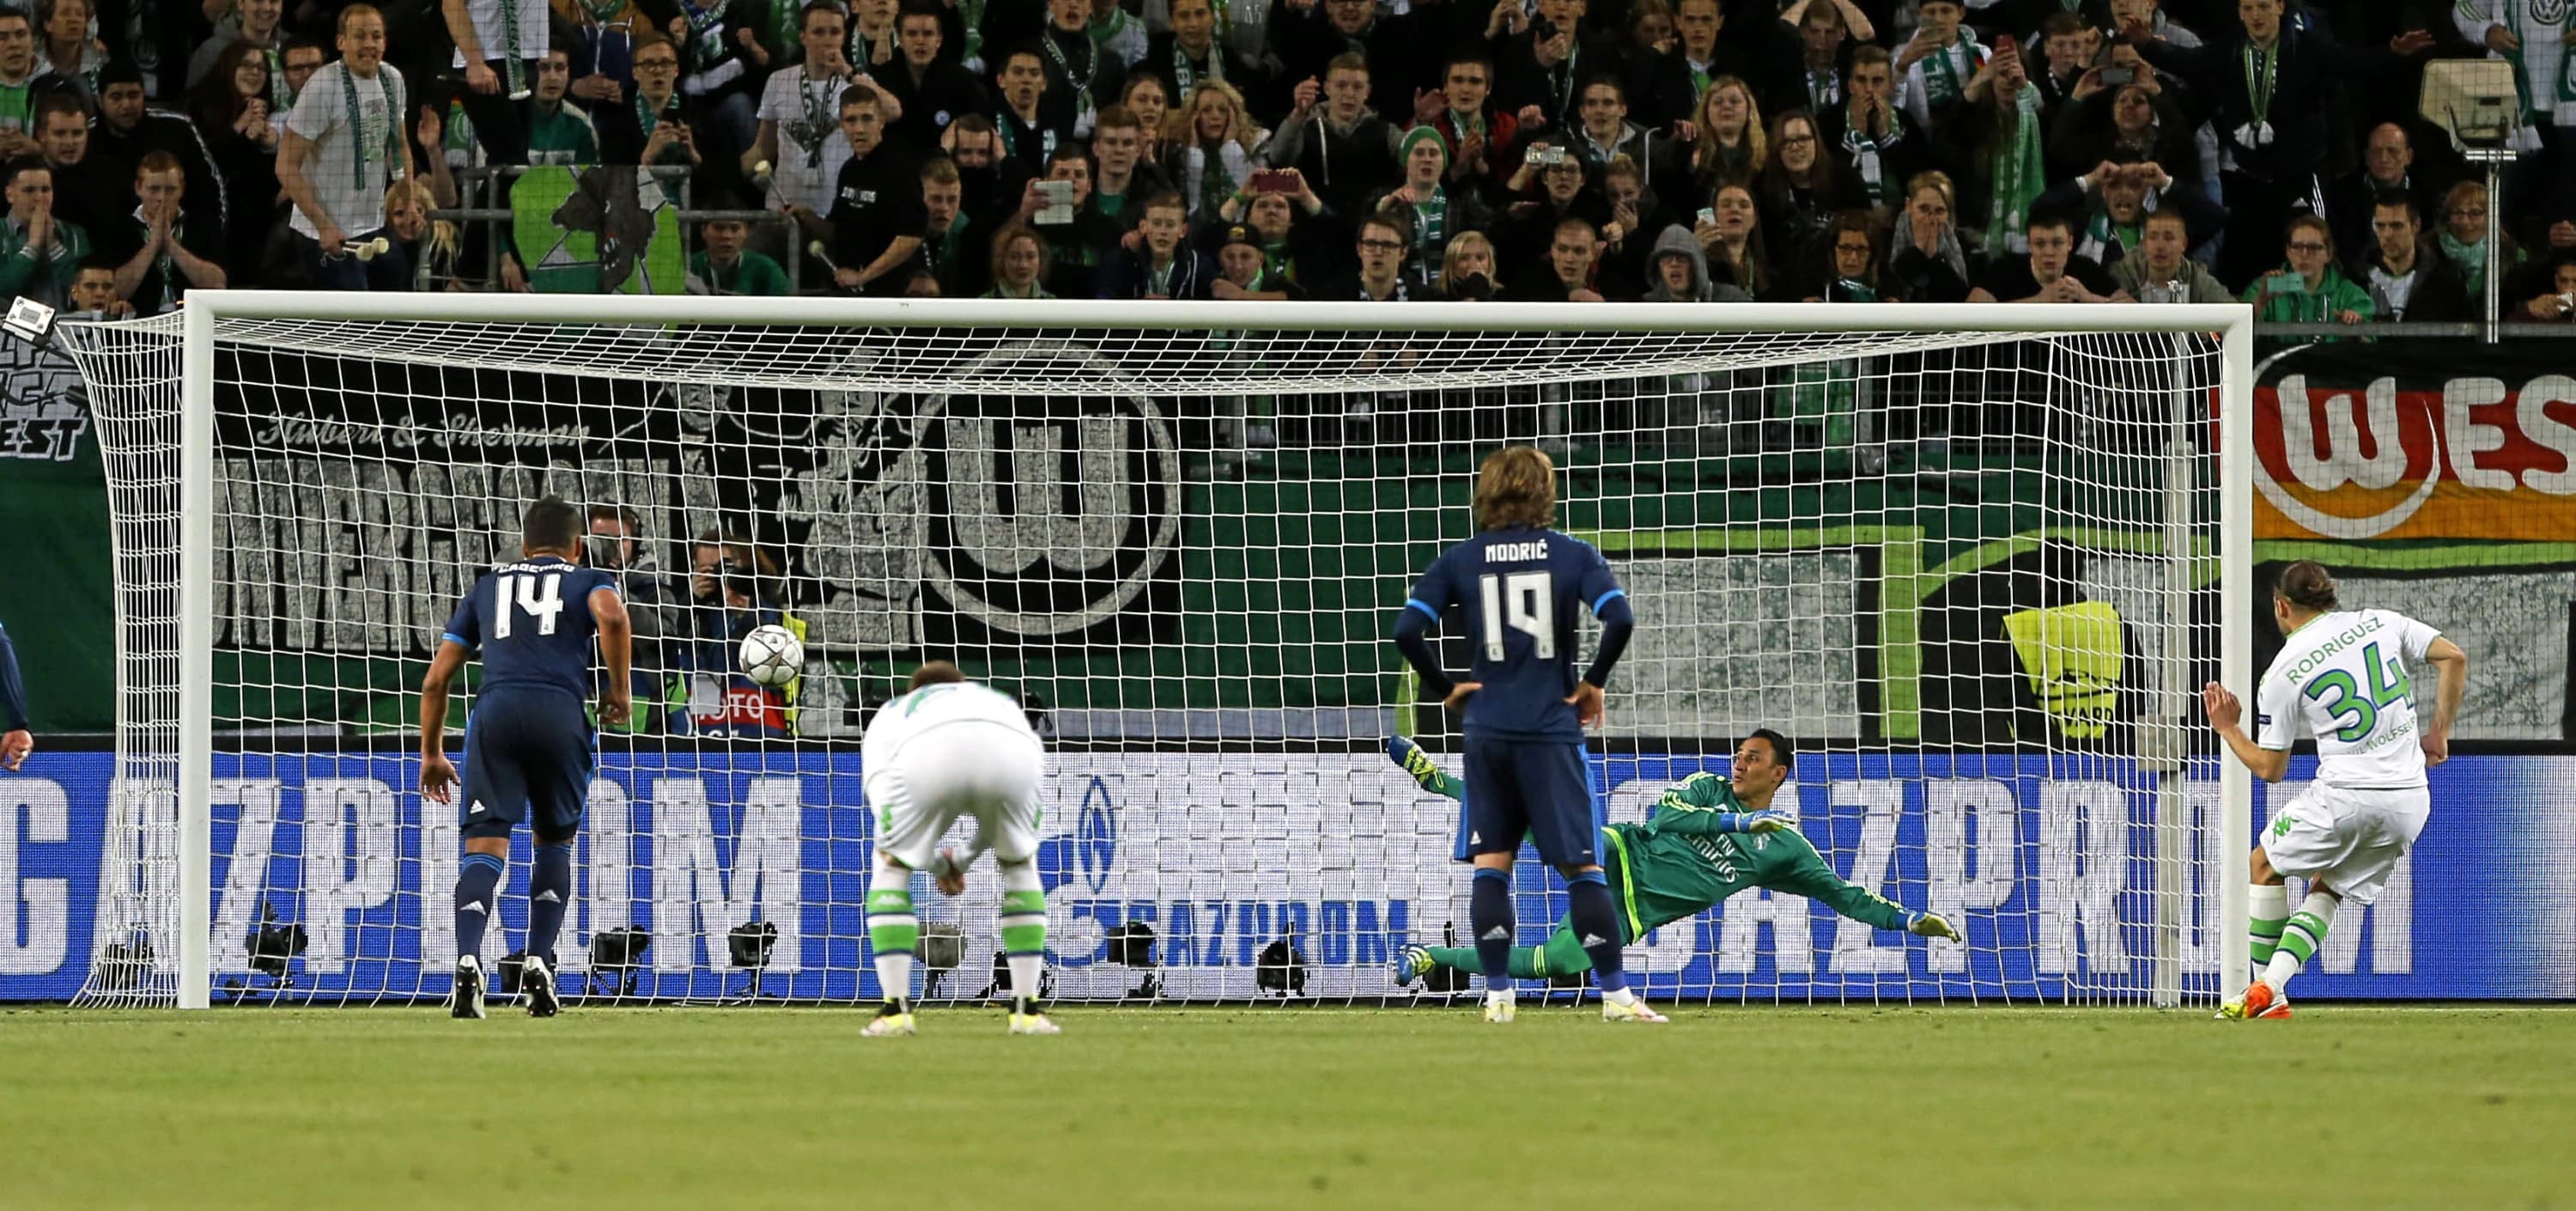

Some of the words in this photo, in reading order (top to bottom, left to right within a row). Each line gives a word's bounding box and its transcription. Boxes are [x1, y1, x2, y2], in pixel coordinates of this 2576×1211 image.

[258, 411, 383, 446] Hubert
[392, 415, 428, 447] &
[432, 412, 591, 447] Sherman
[1485, 539, 1548, 563] MODRIĆ
[495, 573, 563, 639] 14
[1479, 570, 1555, 661] 19
[2286, 616, 2385, 685] RODRÍGUEZ
[698, 693, 765, 721] OTO
[2305, 641, 2415, 742] 34
